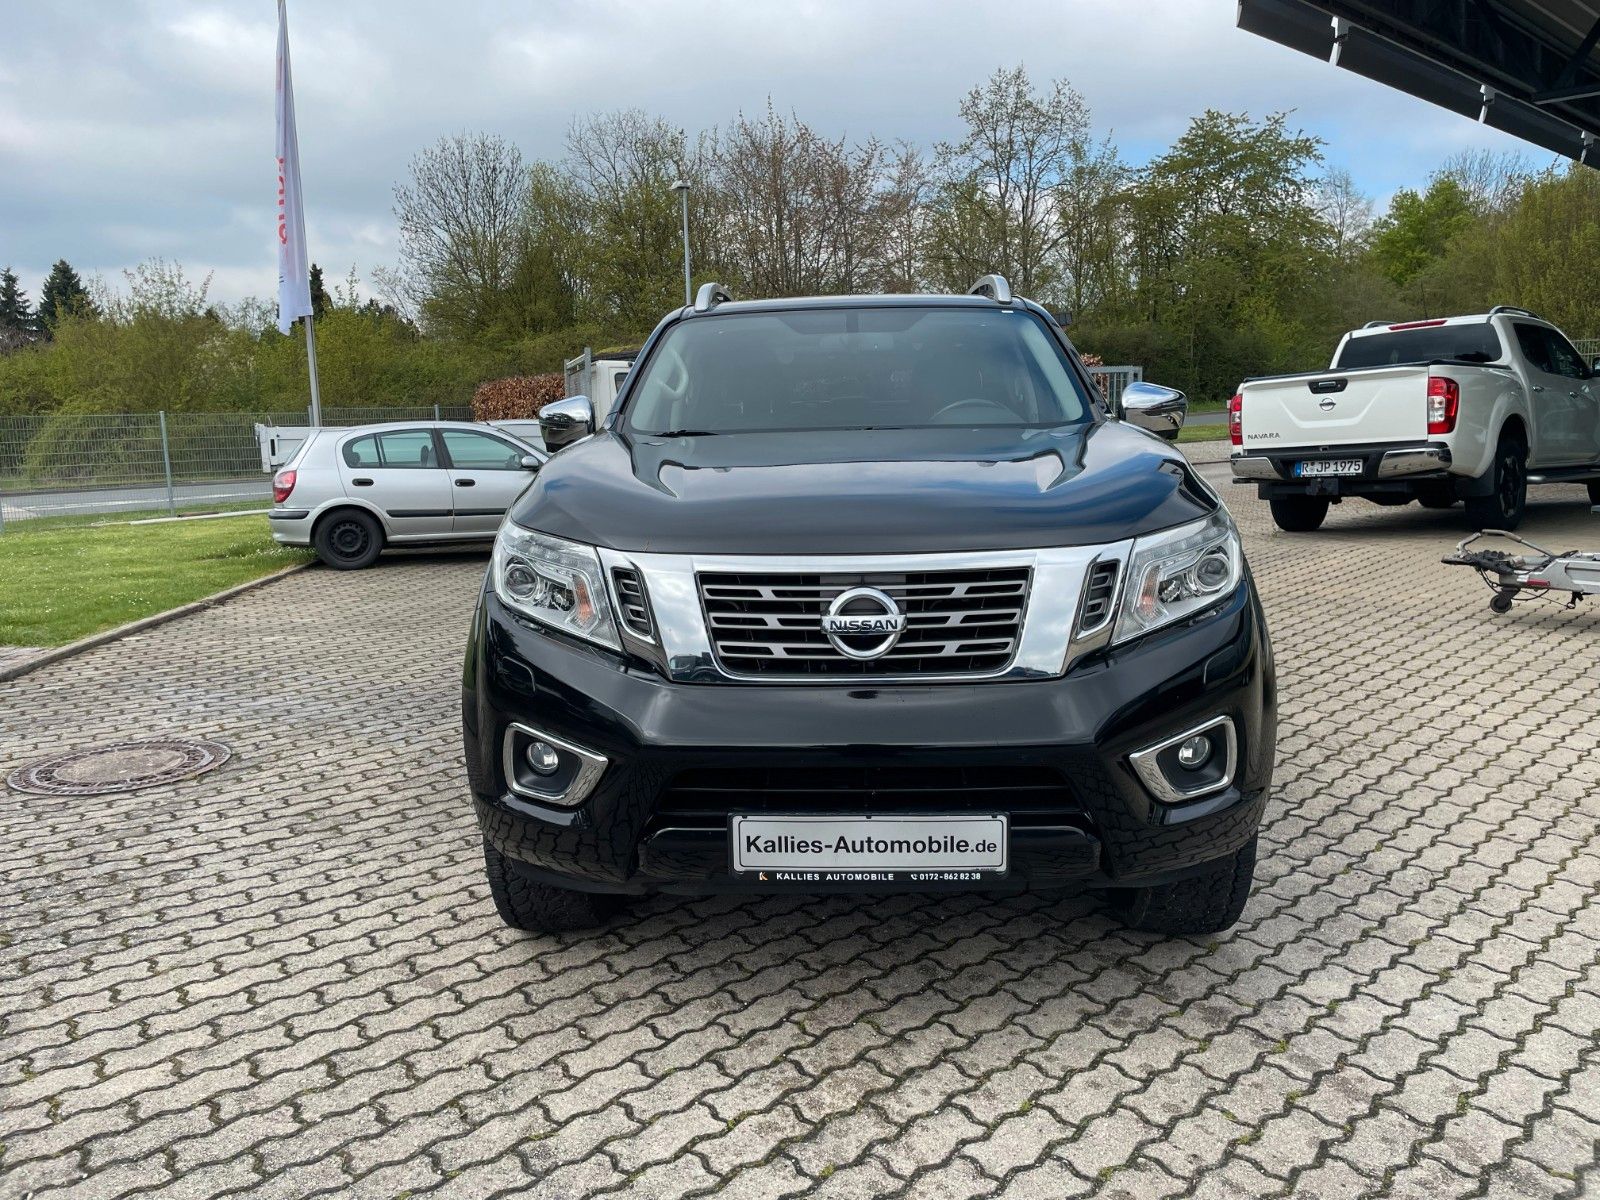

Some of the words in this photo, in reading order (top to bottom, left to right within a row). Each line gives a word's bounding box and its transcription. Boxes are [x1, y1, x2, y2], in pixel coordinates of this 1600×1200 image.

[1247, 432, 1280, 440] NAVARA
[1302, 462, 1309, 474] R
[1316, 461, 1331, 473] JP
[1333, 460, 1361, 472] 1975
[829, 619, 898, 631] NISSAN
[745, 835, 998, 854] Kallies-Automobile.de
[776, 872, 820, 881] KALLIES
[826, 872, 895, 881] AUTOMOBILE
